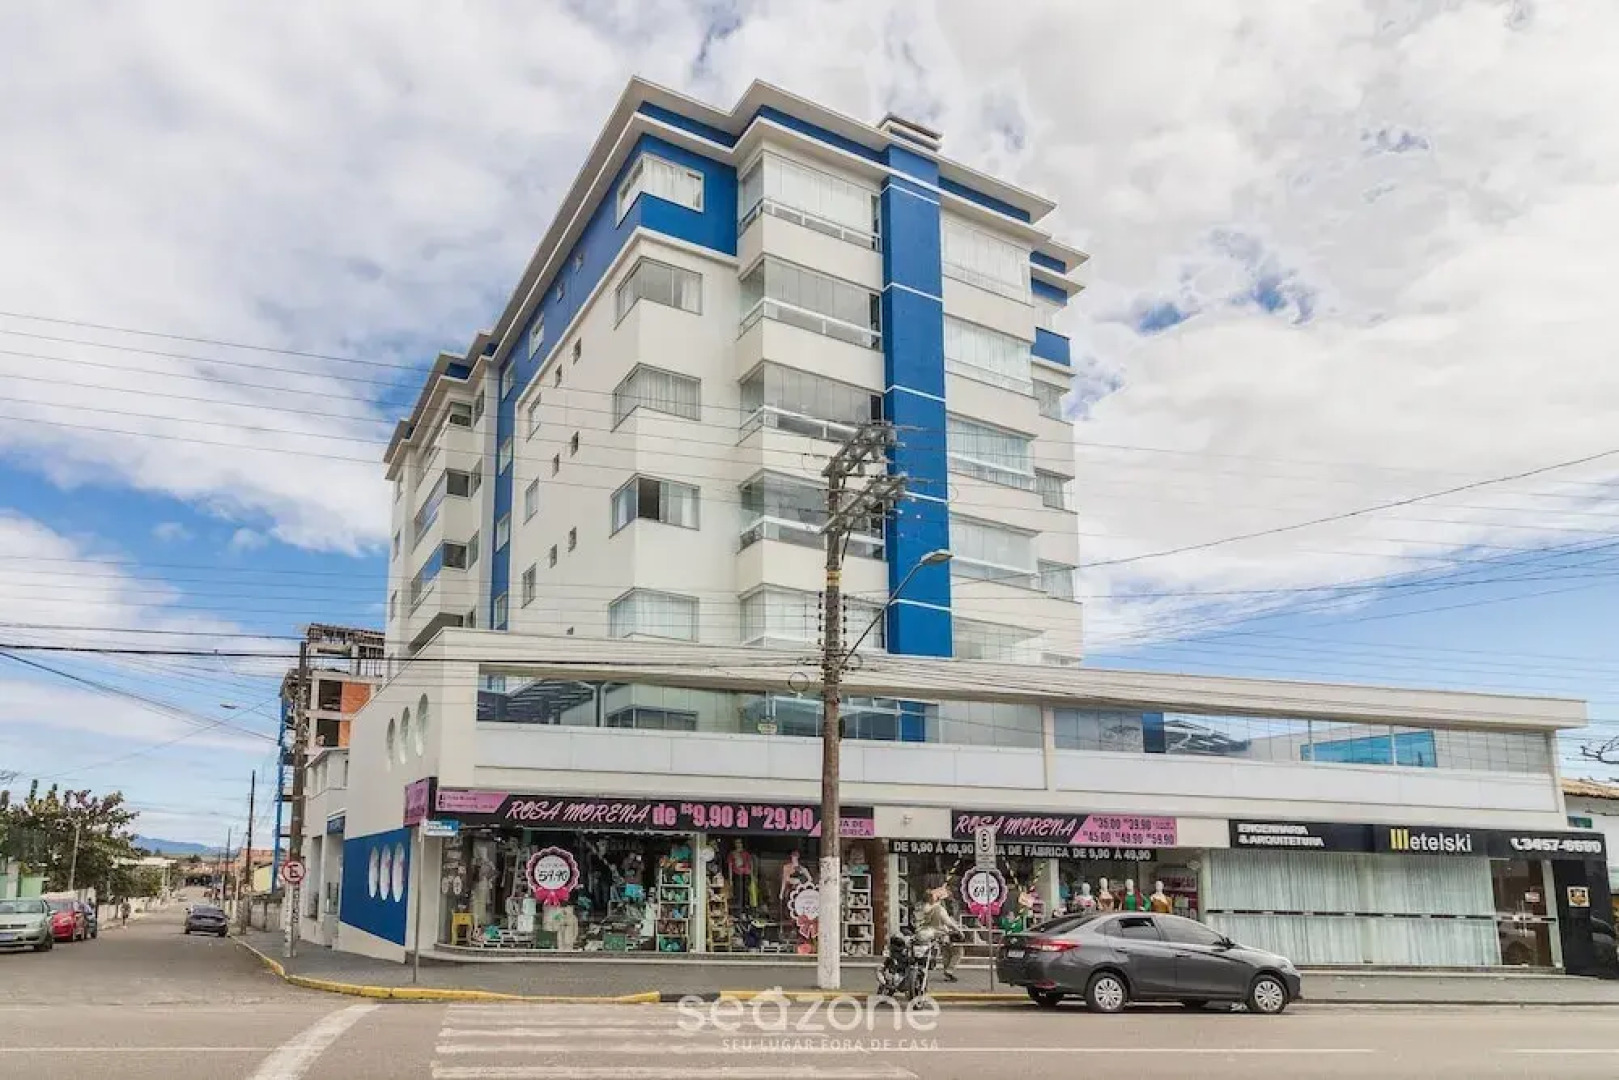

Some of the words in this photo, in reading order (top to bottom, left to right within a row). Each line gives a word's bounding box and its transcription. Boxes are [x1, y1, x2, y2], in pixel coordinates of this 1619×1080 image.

[505, 800, 563, 820] ROSA
[563, 803, 651, 823] MORENA
[652, 803, 677, 826] de
[1004, 817, 1078, 836] MORENA
[894, 841, 909, 853] DE
[1008, 845, 1022, 856] DE
[1073, 848, 1087, 858] DE
